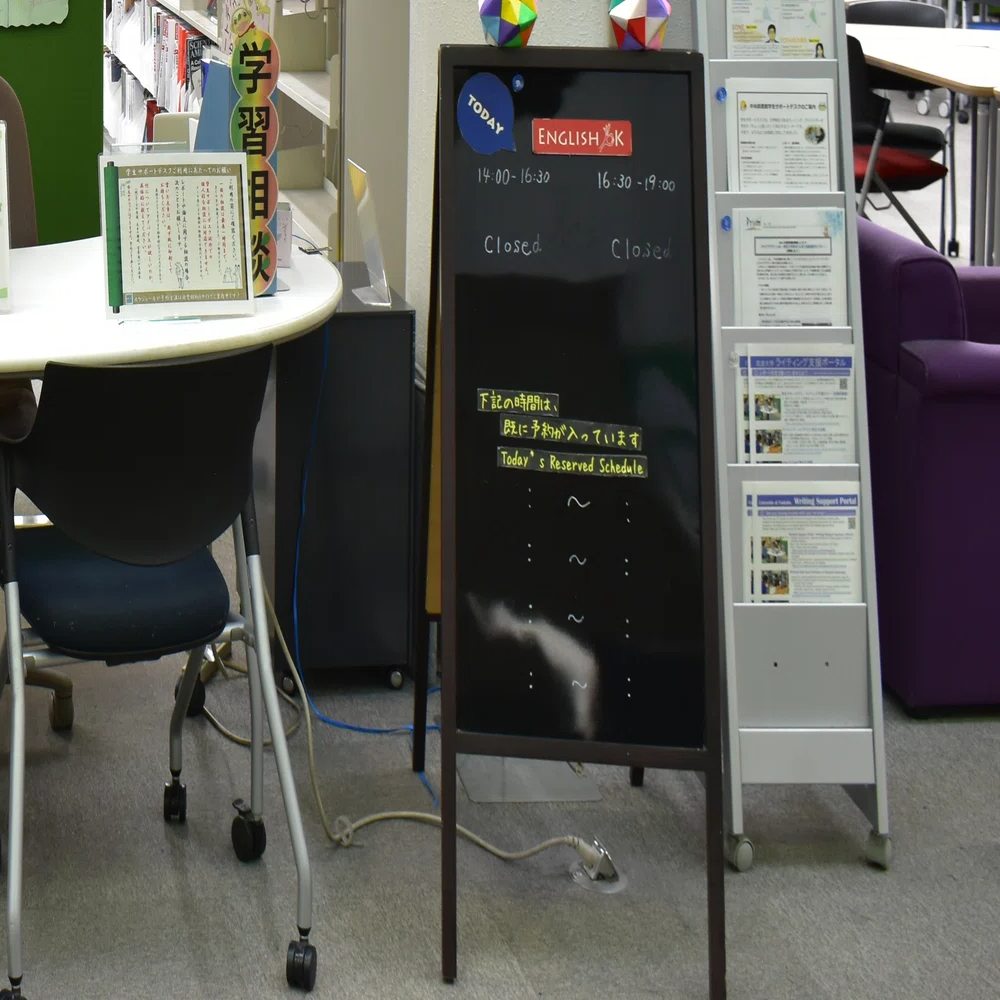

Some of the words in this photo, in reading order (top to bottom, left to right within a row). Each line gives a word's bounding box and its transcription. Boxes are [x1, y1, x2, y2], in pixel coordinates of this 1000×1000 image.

[467, 94, 504, 135] TODAY
[538, 127, 599, 146] ENGLISH
[484, 234, 542, 255] Closed
[611, 237, 672, 260] Closed
[479, 391, 558, 412] 下記の時間は、
[503, 419, 640, 448] 既に予約が入っています
[550, 456, 594, 473] Reserved
[599, 459, 644, 475] Schedule
[816, 497, 838, 506] Support
[839, 497, 857, 505] Portal
